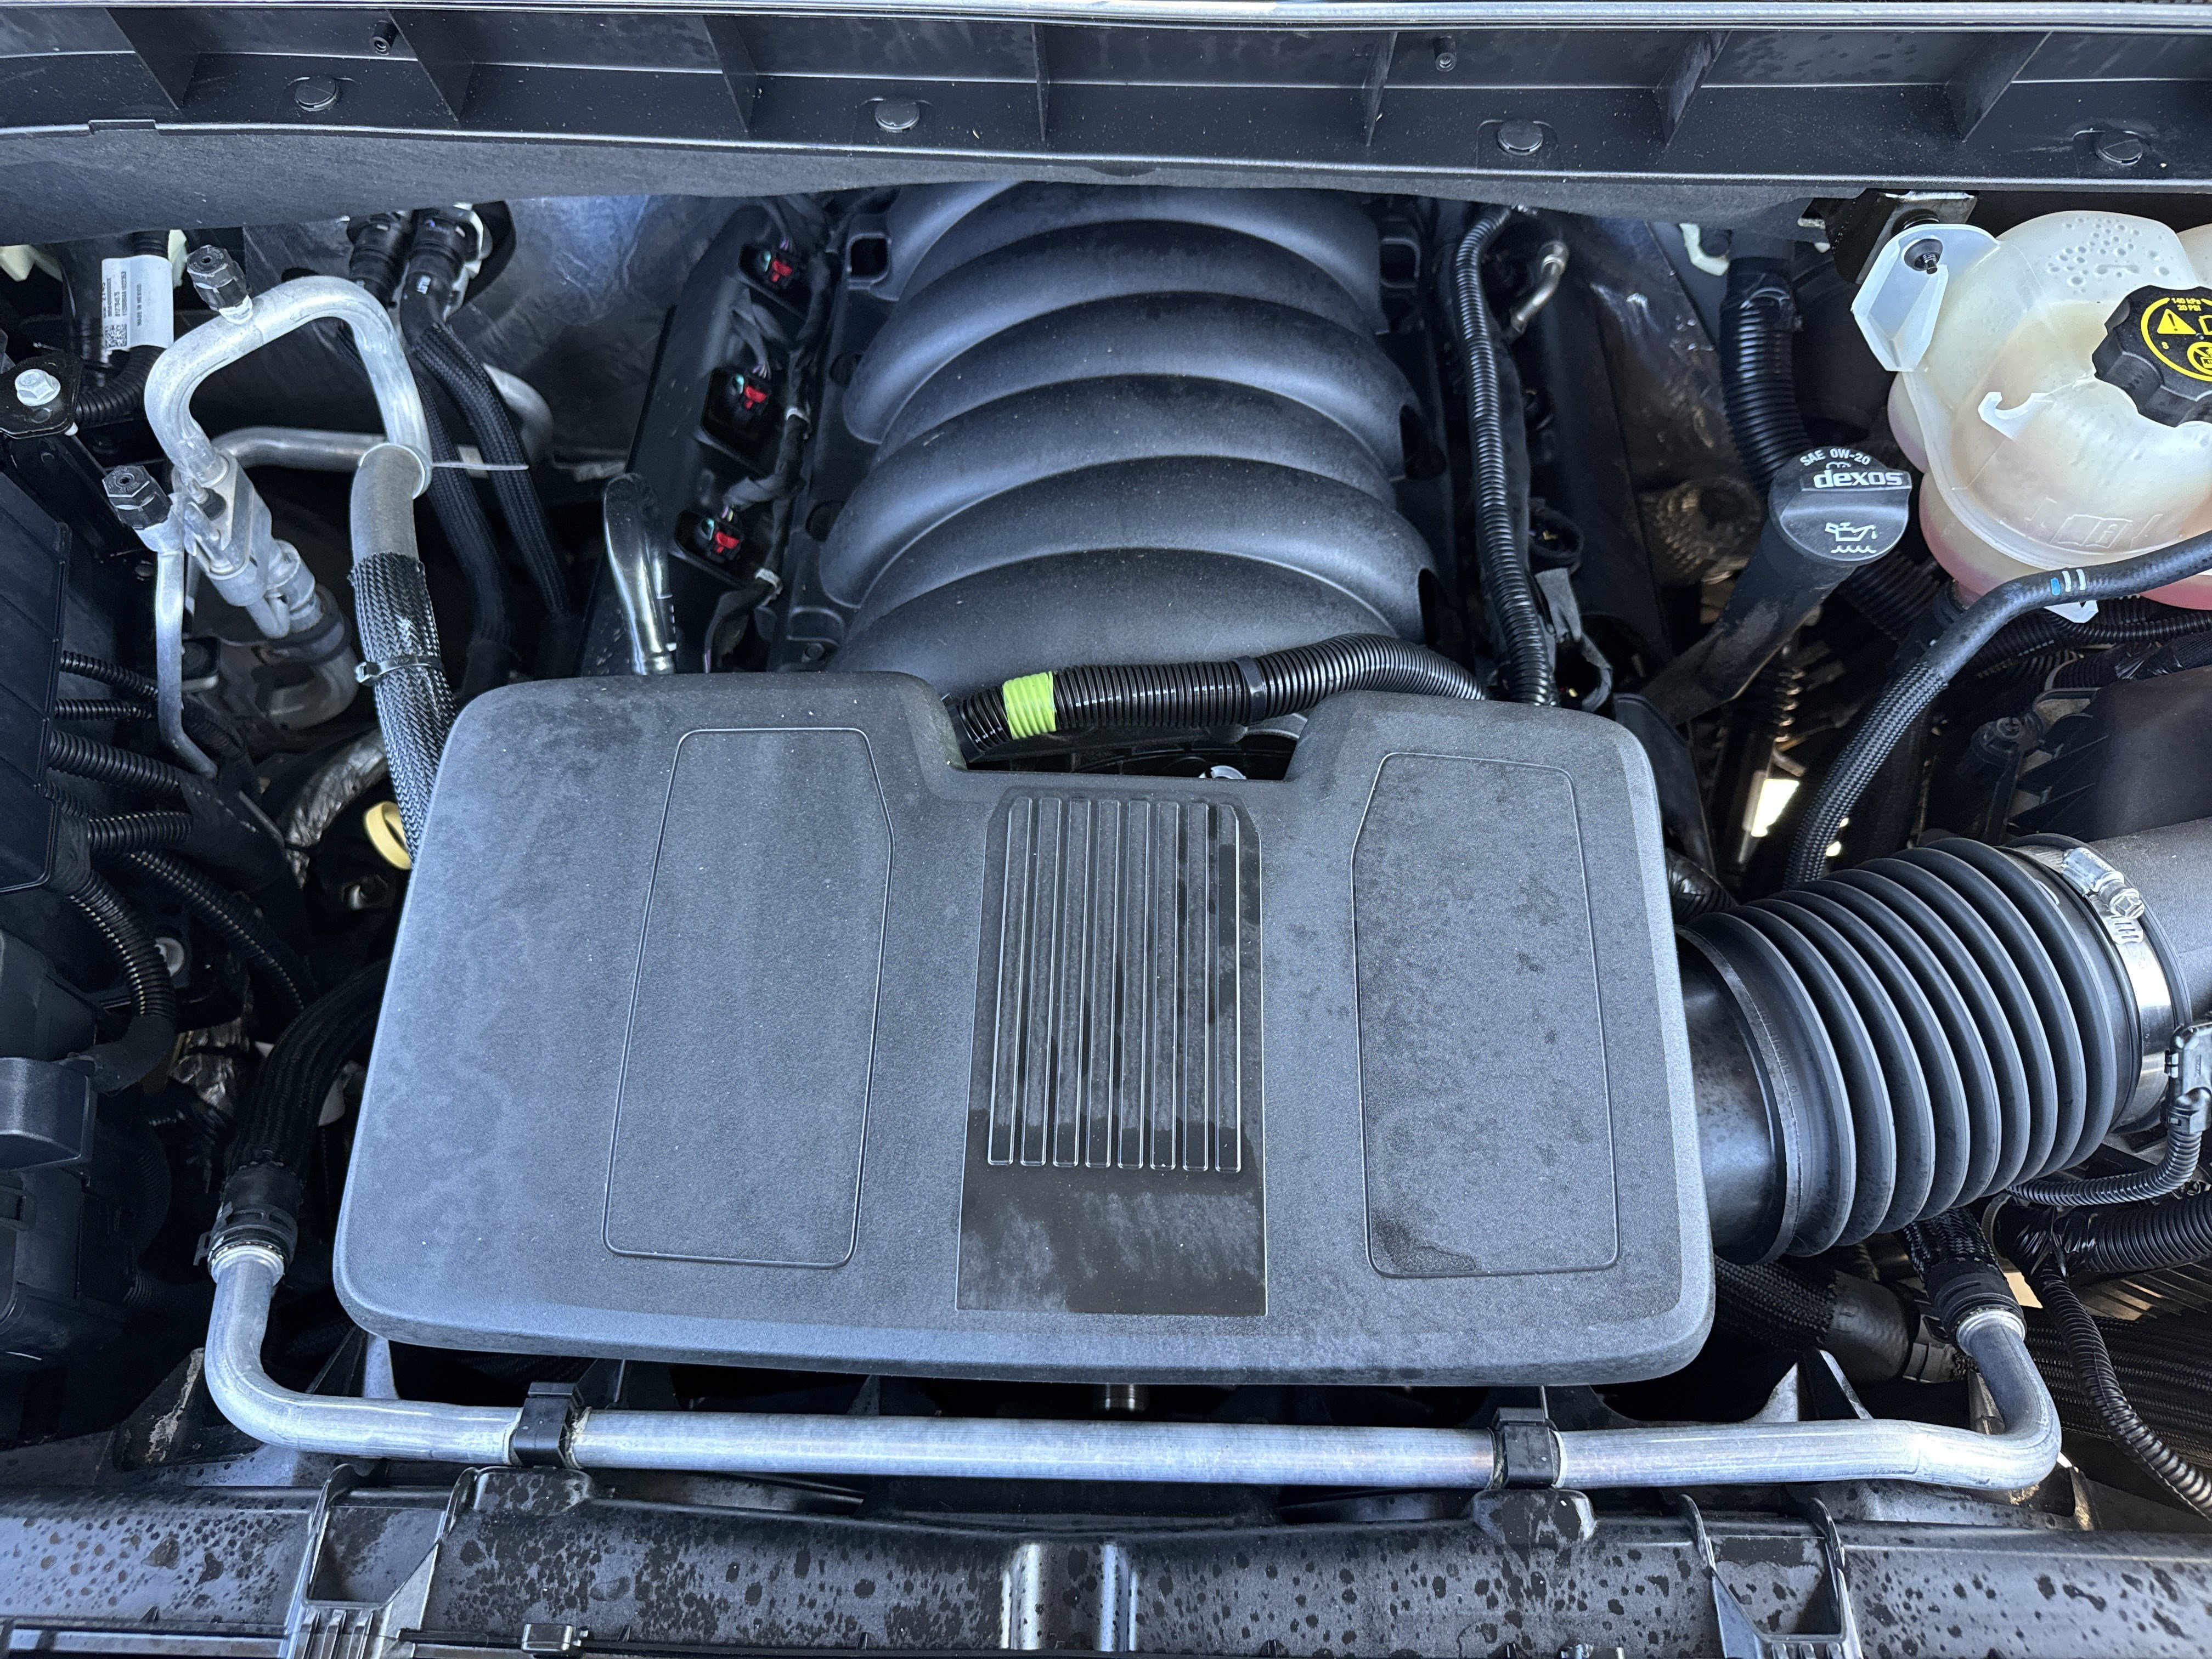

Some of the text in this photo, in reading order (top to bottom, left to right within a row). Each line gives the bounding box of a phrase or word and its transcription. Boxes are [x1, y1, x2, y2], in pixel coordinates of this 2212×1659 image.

[1799, 448, 1871, 466] SAE 0W-20
[1813, 469, 1903, 488] dexos
